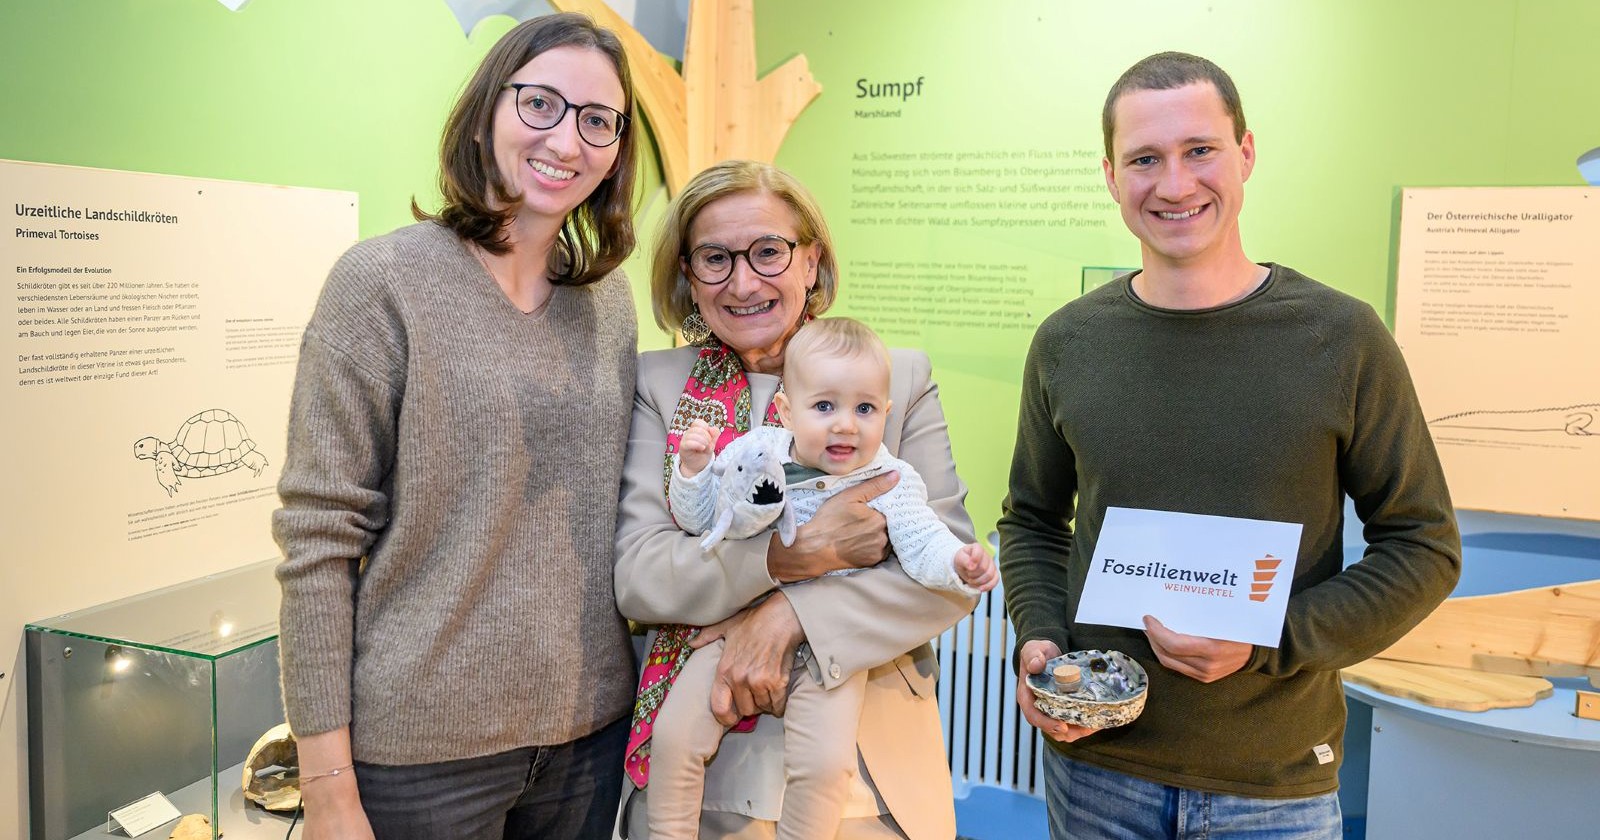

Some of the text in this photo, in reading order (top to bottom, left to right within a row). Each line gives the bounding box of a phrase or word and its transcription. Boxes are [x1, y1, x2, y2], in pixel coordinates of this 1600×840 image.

[856, 76, 924, 101] Sumpf
[855, 110, 901, 118] Marshland
[852, 152, 868, 160] Aus
[956, 150, 1008, 161] gemächlich
[1029, 150, 1052, 158] Fluss
[1056, 150, 1069, 158] ins
[954, 168, 1001, 177] Bisamberg
[1004, 167, 1017, 176] bis
[927, 184, 936, 192] in
[938, 184, 952, 192] der
[955, 184, 973, 192] sich
[999, 184, 1016, 192] und
[851, 200, 895, 208] Zahlreiche
[898, 200, 947, 209] Seitenarme
[949, 201, 996, 209] umflossen
[999, 201, 1027, 209] kleine
[1030, 201, 1048, 209] und
[1051, 201, 1089, 211] größere
[15, 204, 178, 223] Urzeitliche Landschildkröten
[1427, 211, 1573, 222] Der Österreichische Uralligator
[895, 216, 925, 225] dichter
[928, 217, 950, 225] Wald
[971, 218, 1045, 229] Sumpfzypressen
[1047, 218, 1066, 227] und
[16, 228, 99, 240] Primeval Tortoises
[29, 267, 71, 275] Erfolgsmodell
[65, 329, 81, 337] legen
[45, 352, 79, 360] vollständig
[19, 365, 68, 374] Landschildkröte
[1102, 558, 1238, 586] Fossilienwelt
[1164, 583, 1234, 597] WEINVIERTEL
